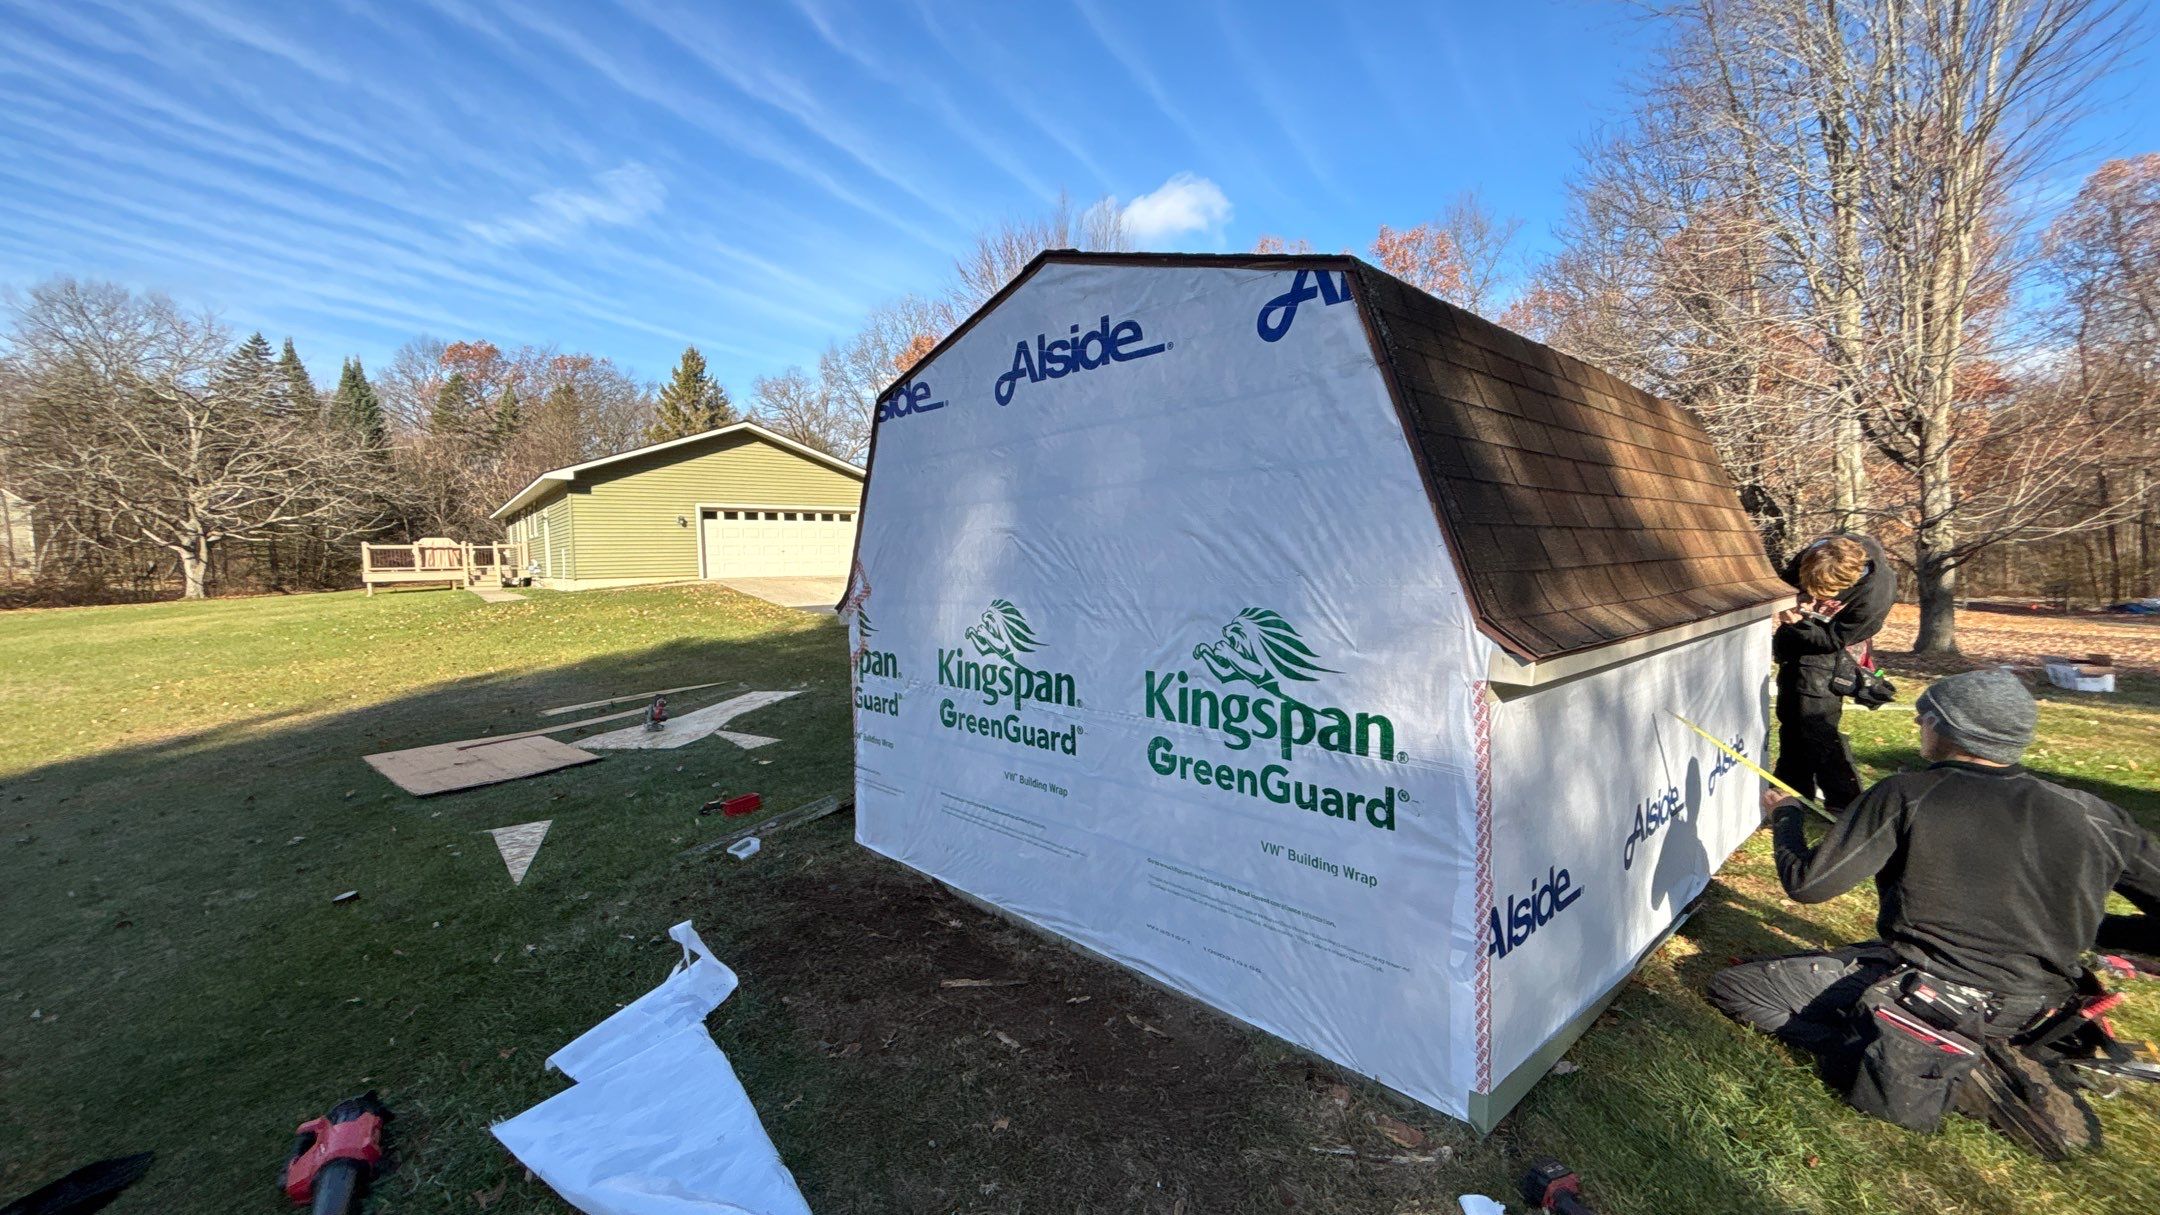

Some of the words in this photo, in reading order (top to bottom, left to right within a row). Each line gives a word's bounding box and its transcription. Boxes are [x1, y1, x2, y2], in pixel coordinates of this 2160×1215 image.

[994, 315, 1166, 407] Alside
[938, 648, 1076, 711] Kingspan
[1145, 669, 1395, 762] Kingspan
[939, 698, 1077, 756] GreenGuard
[1019, 774, 1047, 792] Building
[1049, 782, 1069, 798] Wrap
[1147, 735, 1396, 831] GreenGuard
[1624, 785, 1685, 871] Alside
[1287, 848, 1339, 877] Building
[1342, 864, 1378, 888] Wrap
